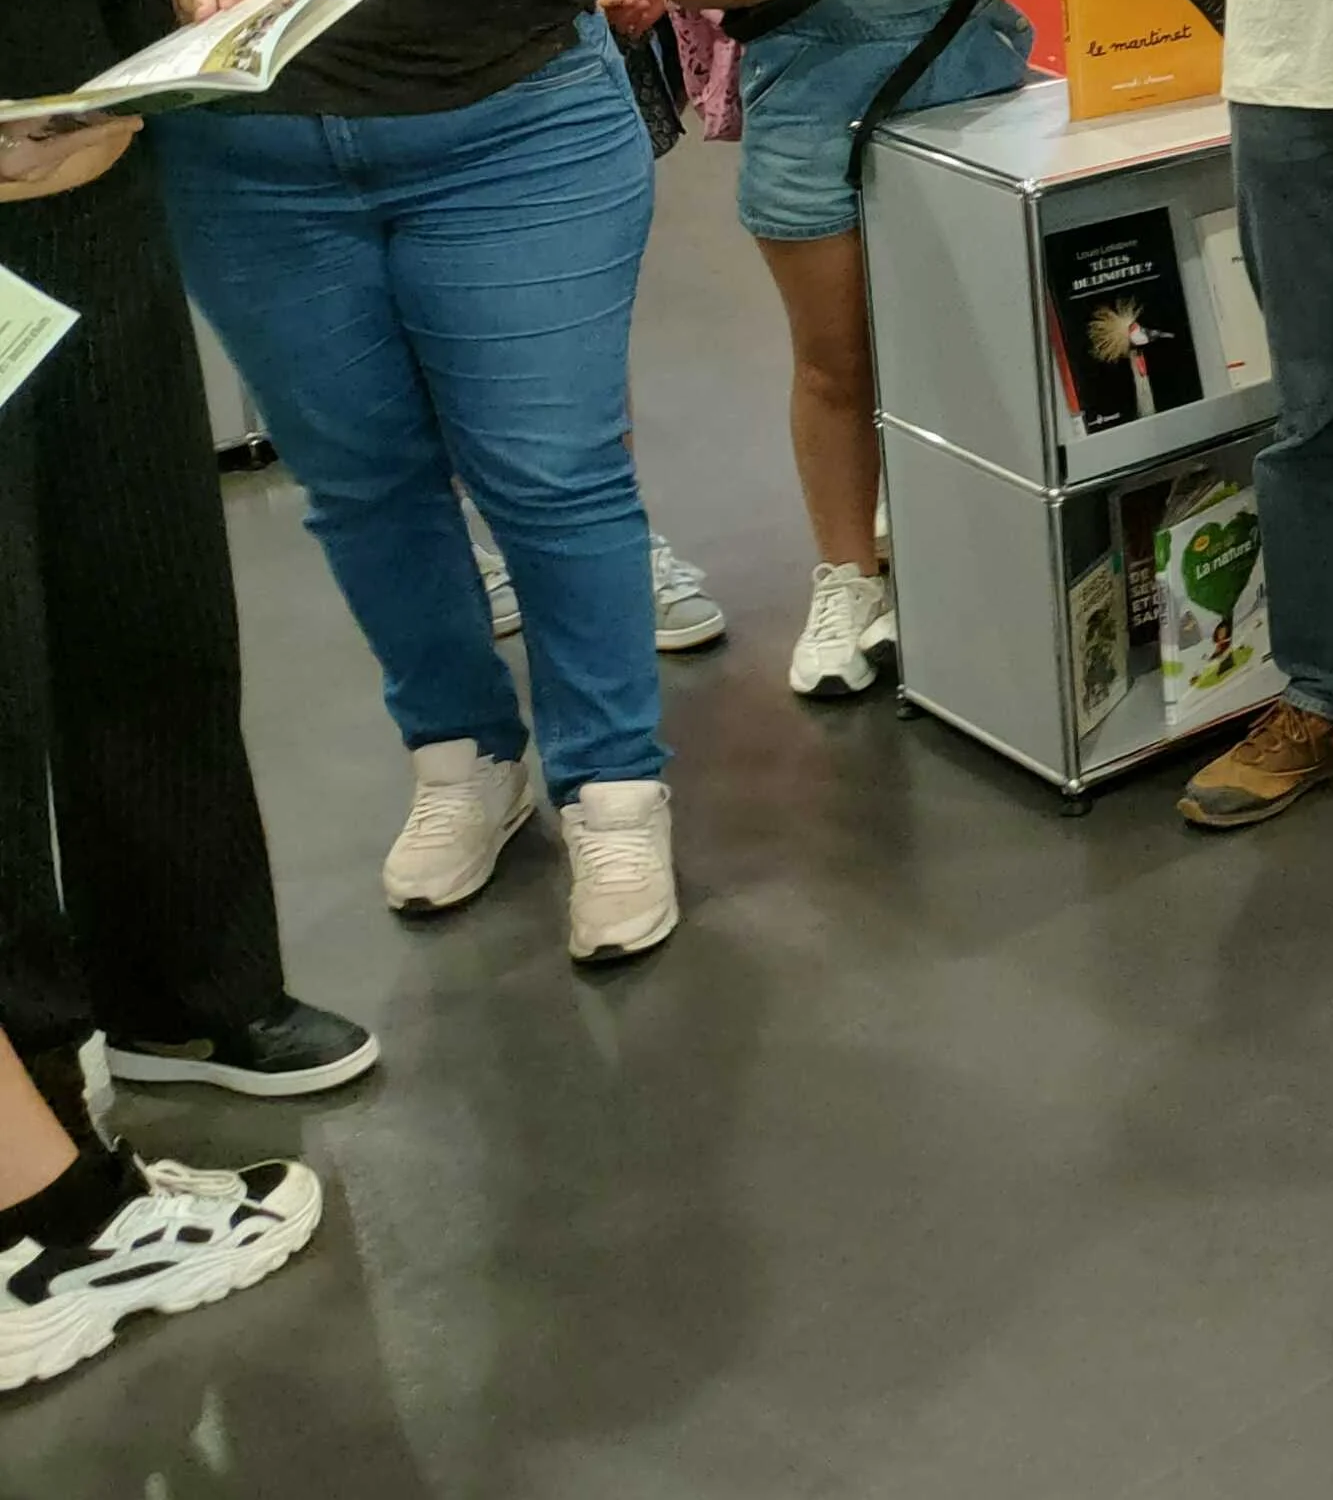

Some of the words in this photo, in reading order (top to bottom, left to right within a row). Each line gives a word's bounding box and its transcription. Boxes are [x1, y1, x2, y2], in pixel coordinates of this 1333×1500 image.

[1086, 41, 1106, 57] le
[1109, 24, 1192, 52] martinet
[1195, 561, 1211, 581] La
[1213, 540, 1251, 571] nature
